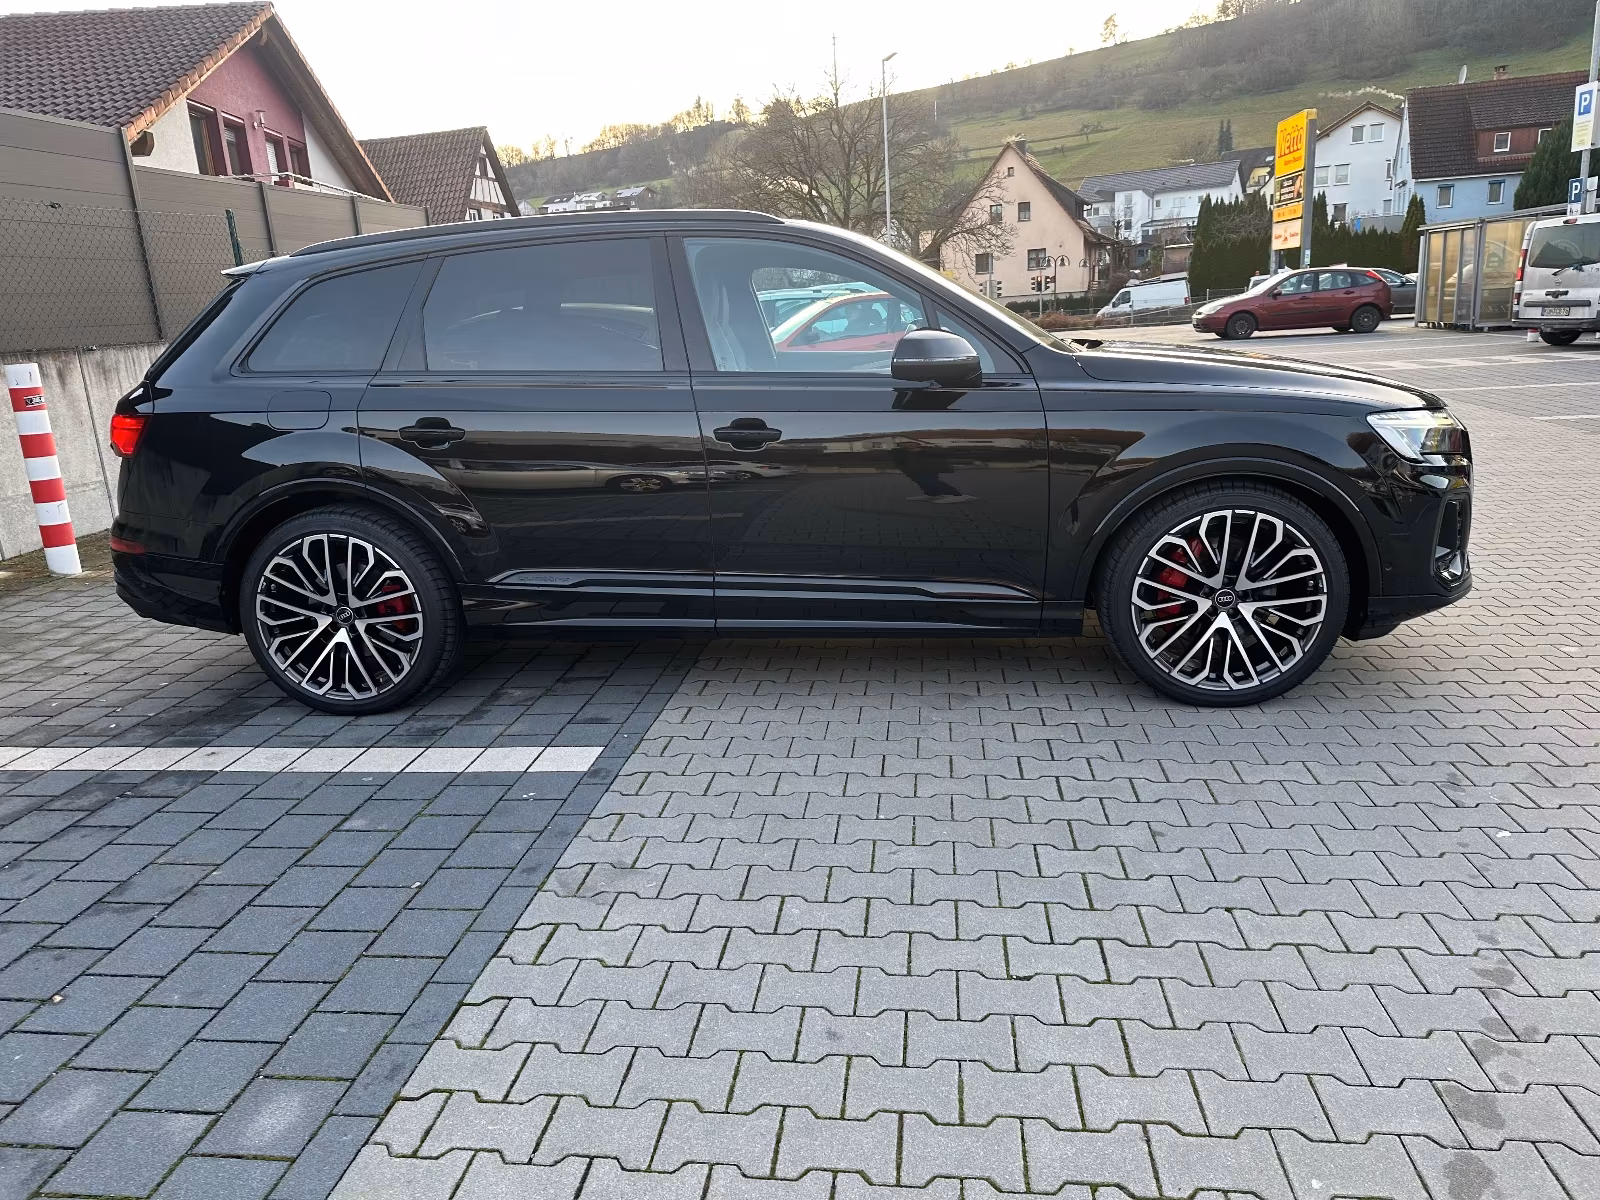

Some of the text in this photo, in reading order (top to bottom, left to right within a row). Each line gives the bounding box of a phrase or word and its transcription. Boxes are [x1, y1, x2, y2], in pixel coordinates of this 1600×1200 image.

[1580, 94, 1590, 113] P
[1278, 124, 1304, 158] Netto
[1571, 182, 1580, 201] P
